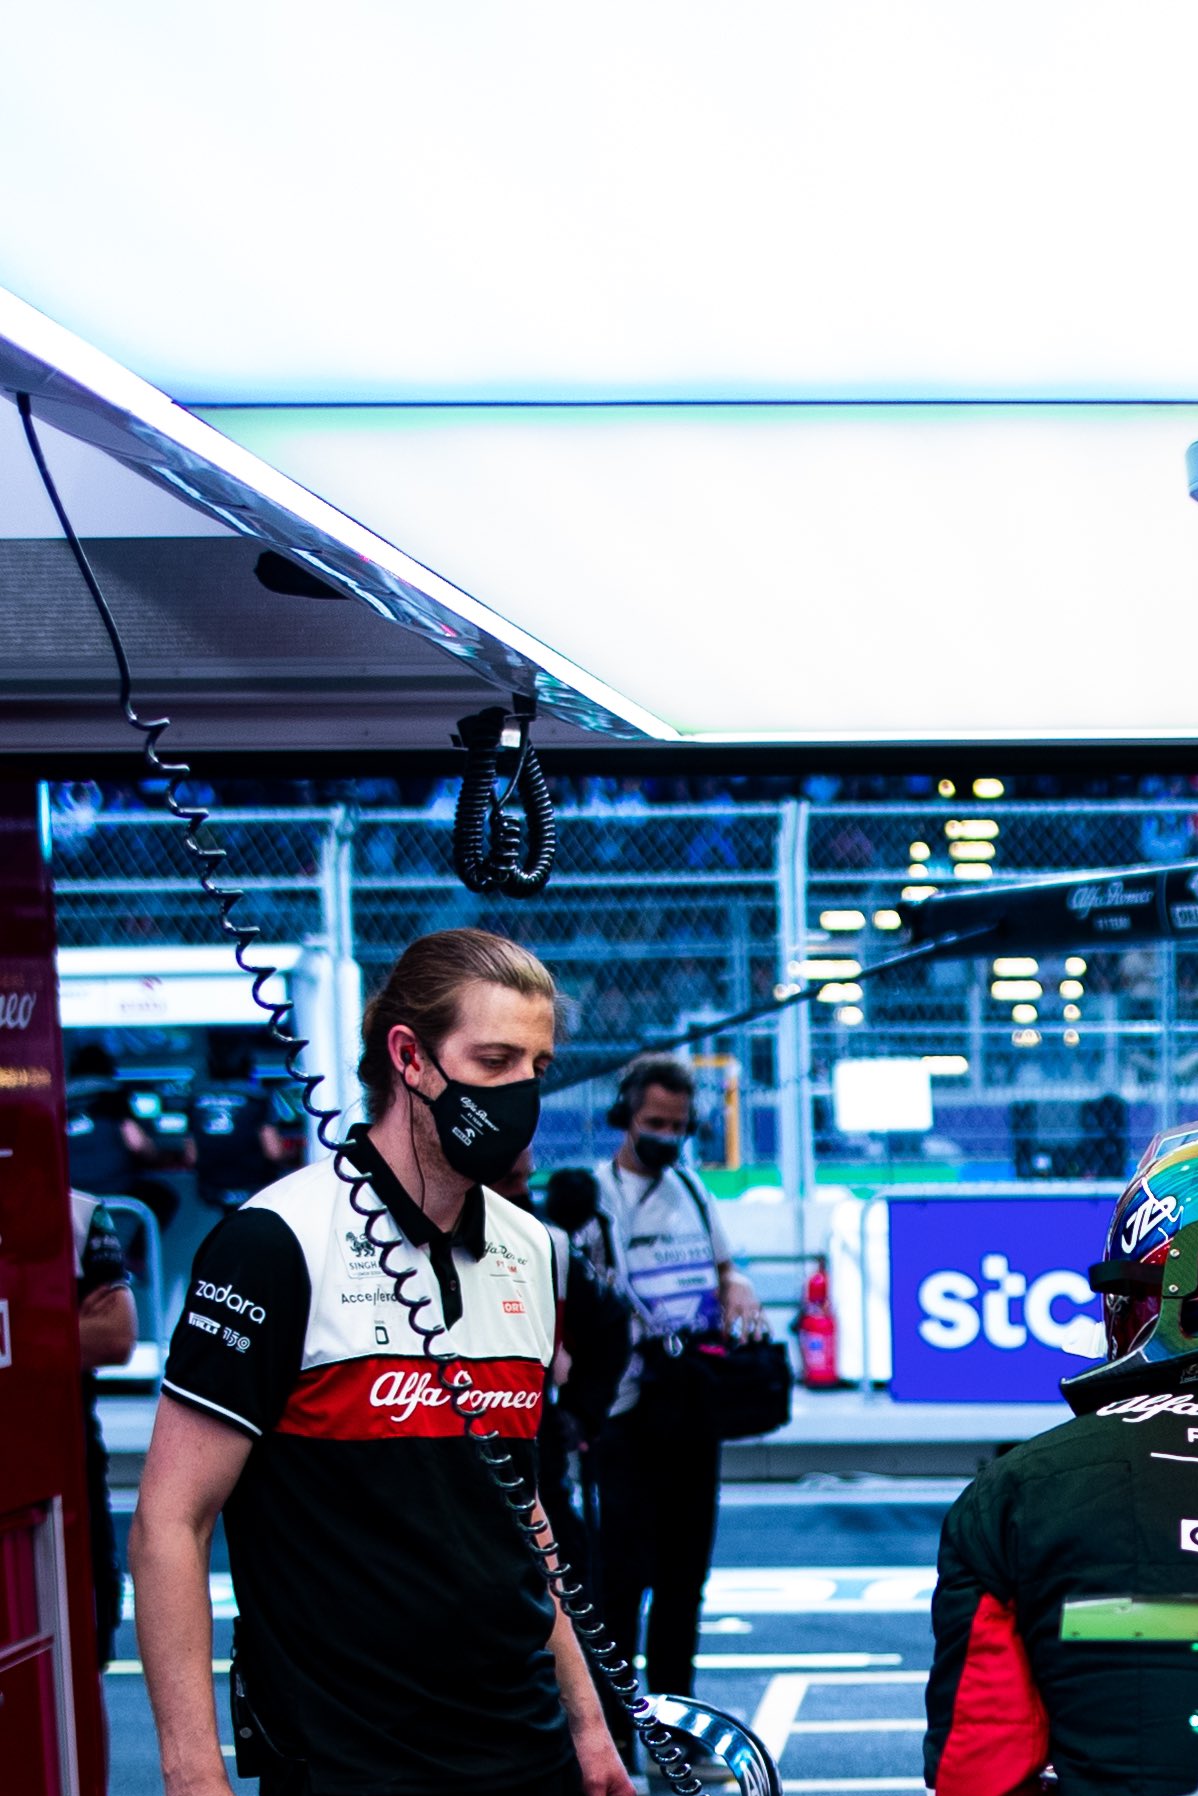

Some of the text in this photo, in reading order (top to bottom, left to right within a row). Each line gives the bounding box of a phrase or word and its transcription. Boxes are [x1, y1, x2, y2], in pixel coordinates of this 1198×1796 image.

[349, 1261, 380, 1271] SINGH
[195, 1280, 266, 1325] zadara
[918, 1254, 1098, 1350] stc
[370, 1371, 451, 1422] Alfa
